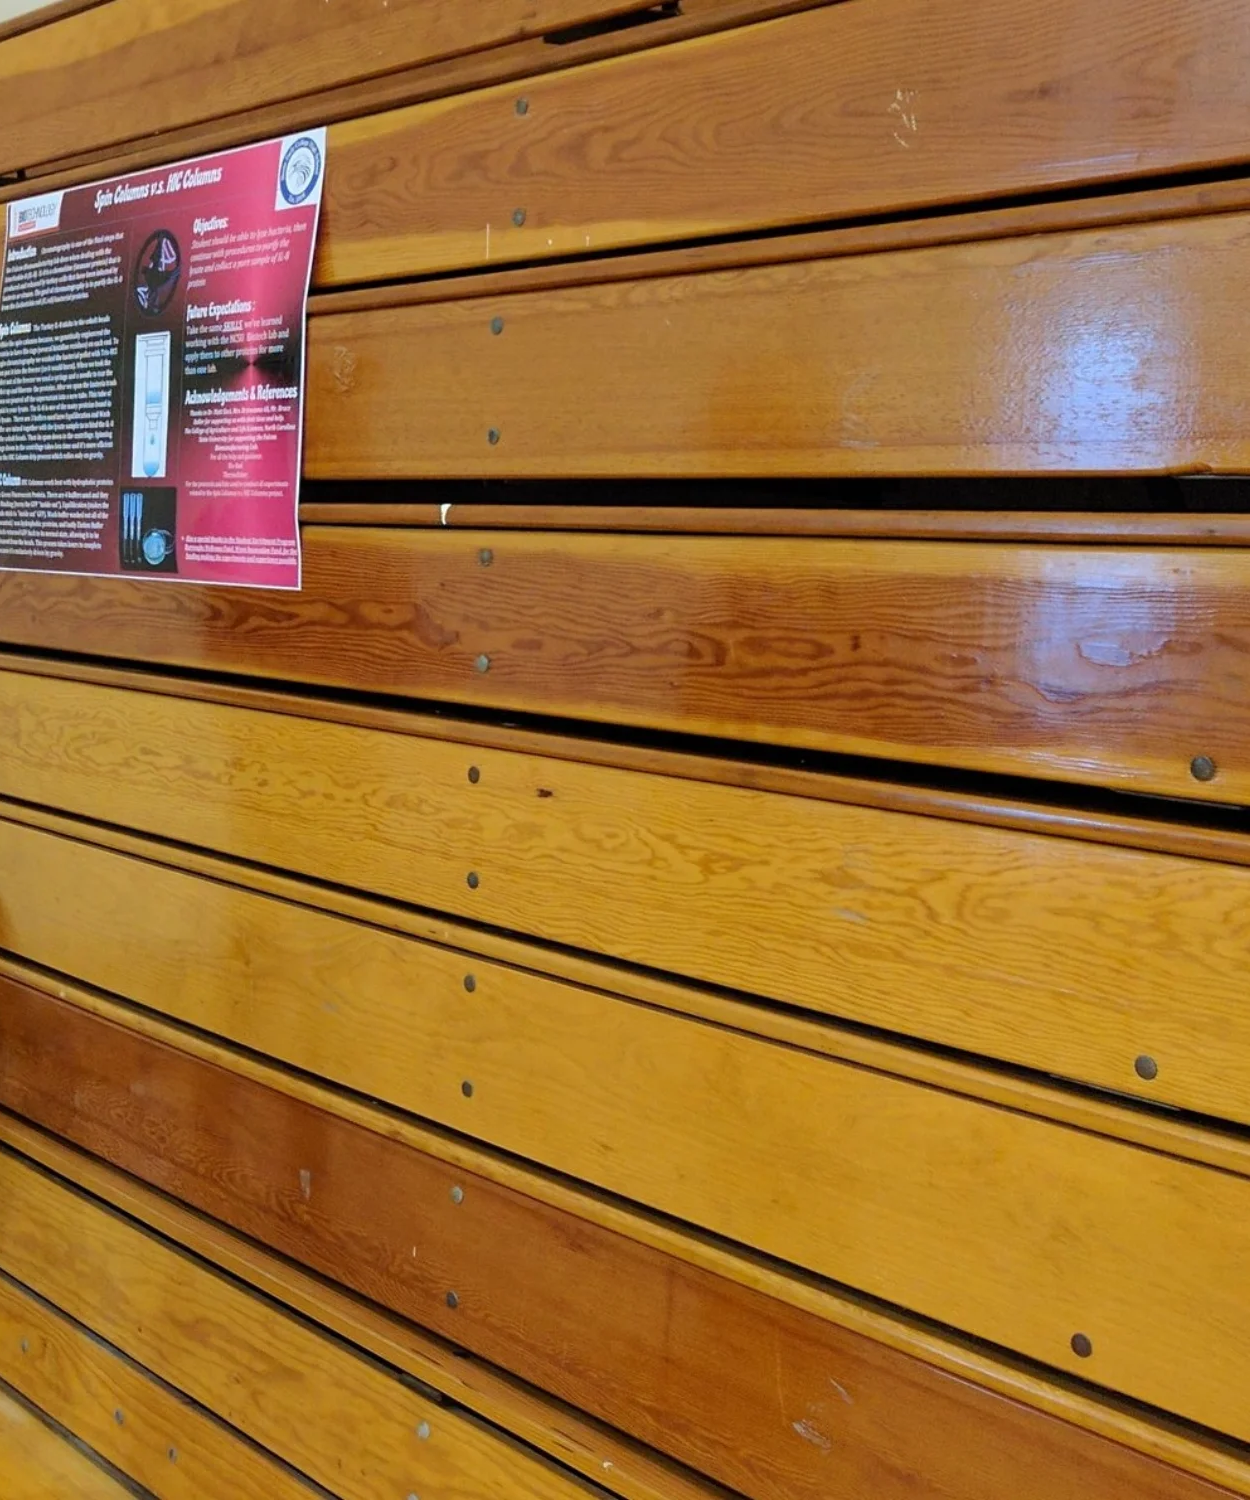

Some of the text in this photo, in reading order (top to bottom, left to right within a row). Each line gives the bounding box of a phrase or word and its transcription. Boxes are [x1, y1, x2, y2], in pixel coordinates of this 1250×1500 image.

[94, 190, 113, 214] Spin
[114, 182, 150, 205] Columns
[182, 166, 223, 189] Columns
[187, 303, 208, 322] Future
[186, 325, 198, 336] Take
[250, 385, 256, 401] &
[256, 384, 298, 402] References
